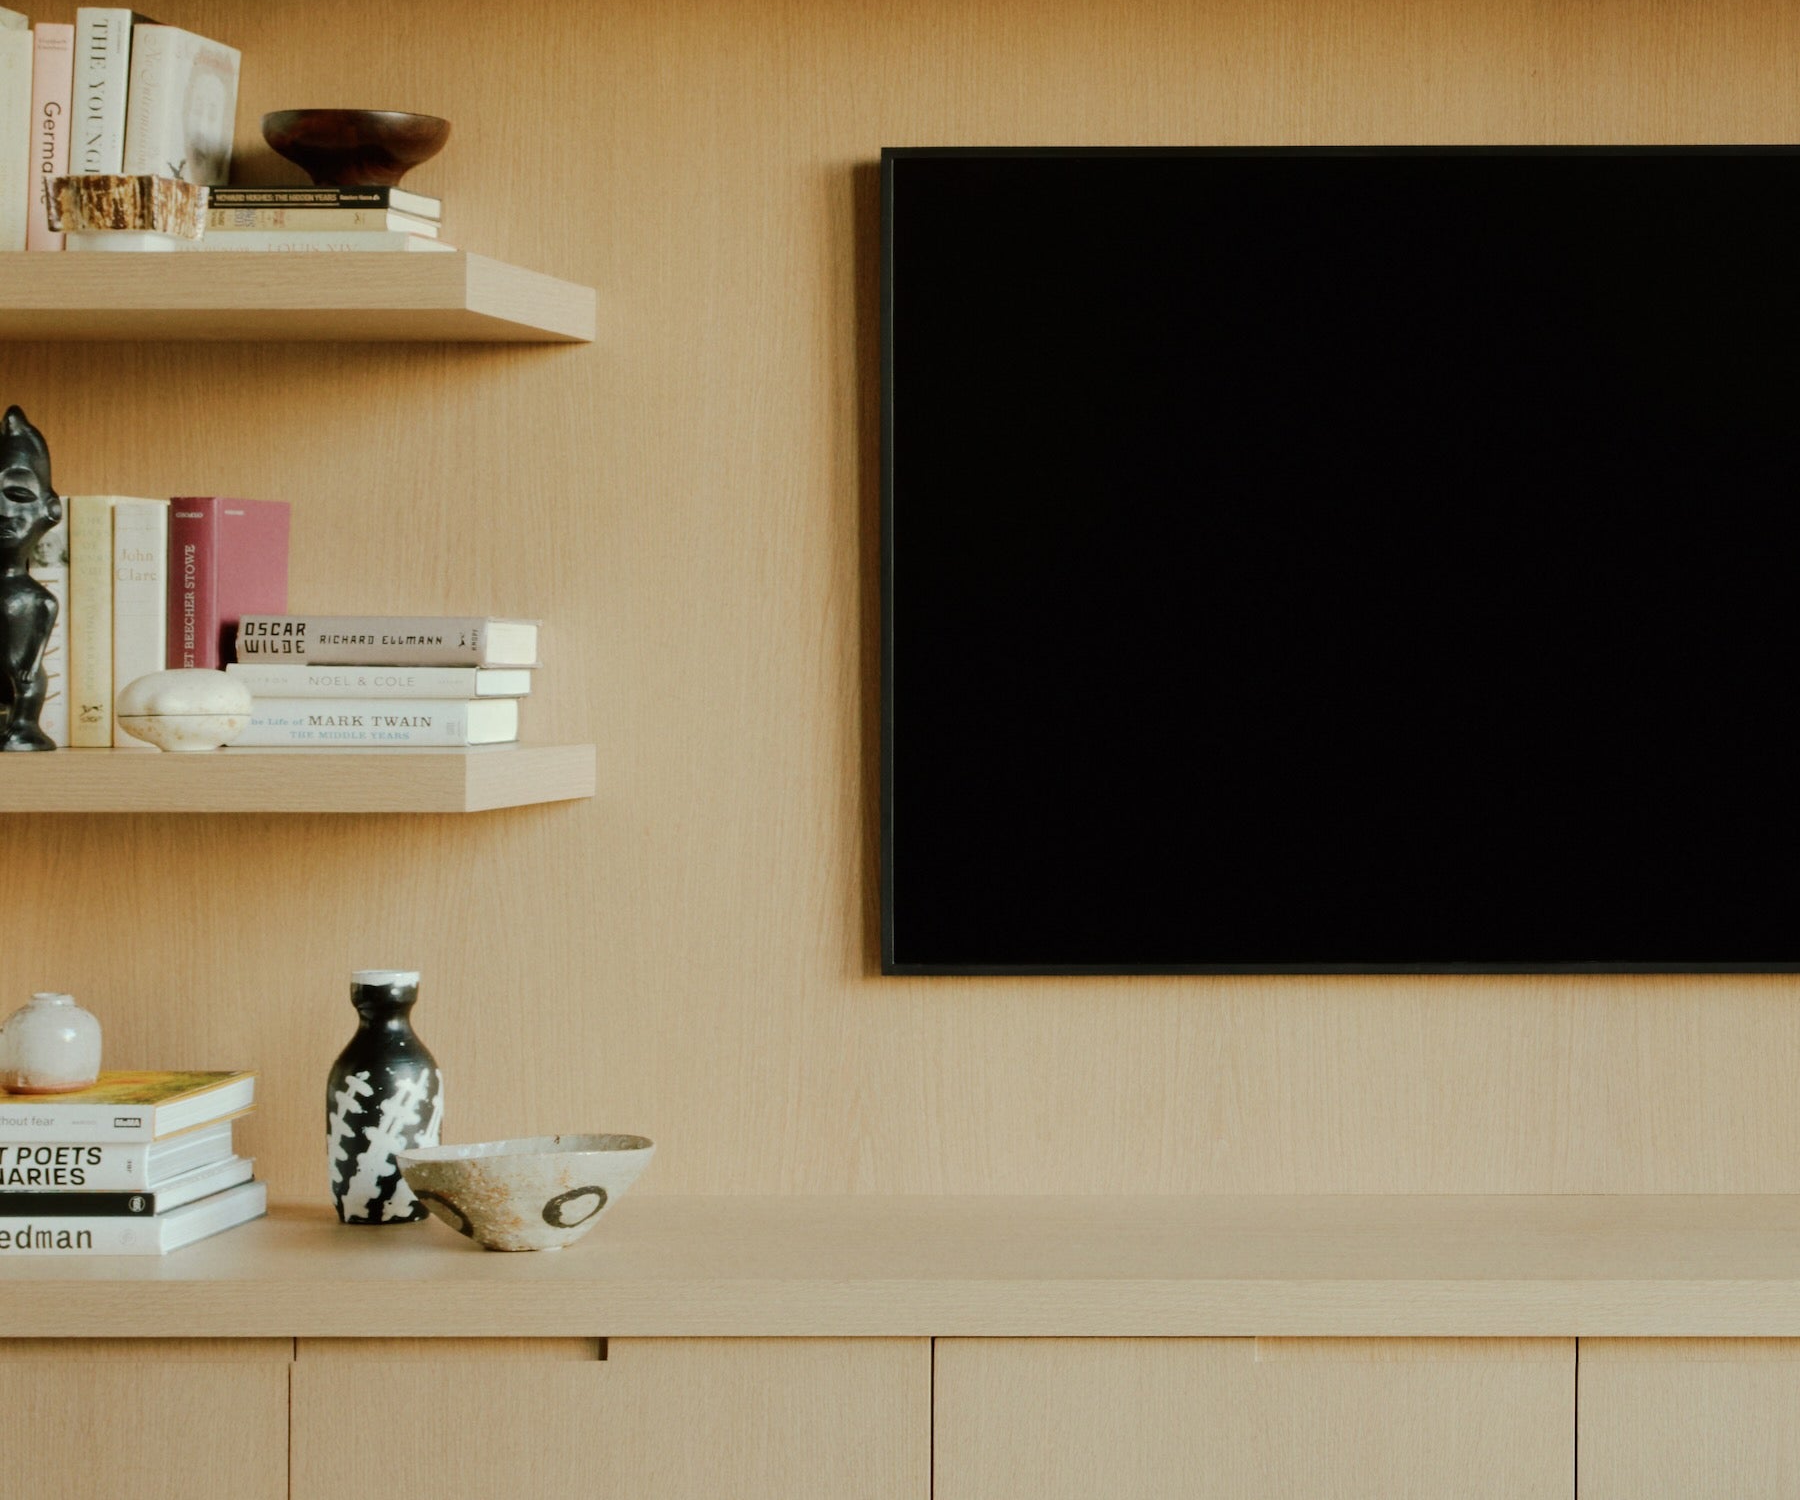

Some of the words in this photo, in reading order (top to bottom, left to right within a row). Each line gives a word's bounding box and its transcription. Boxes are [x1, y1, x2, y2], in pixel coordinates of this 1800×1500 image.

[184, 544, 196, 590] STOWE
[183, 593, 195, 650] BEECHER
[244, 622, 306, 636] OSCAR
[319, 635, 374, 645] RICHARD
[382, 636, 443, 645] ELLMANN
[244, 639, 306, 654] WILDE
[309, 676, 350, 686] NOEL
[357, 676, 367, 686] &
[374, 676, 416, 687] COLE
[251, 718, 265, 726] he
[268, 717, 289, 726] Life
[292, 717, 303, 726] of
[308, 716, 364, 727] MARK
[371, 716, 432, 727] TWAIN
[319, 731, 367, 739] MIDDLE
[31, 1116, 55, 1126] fear
[16, 1147, 103, 1165] POETS
